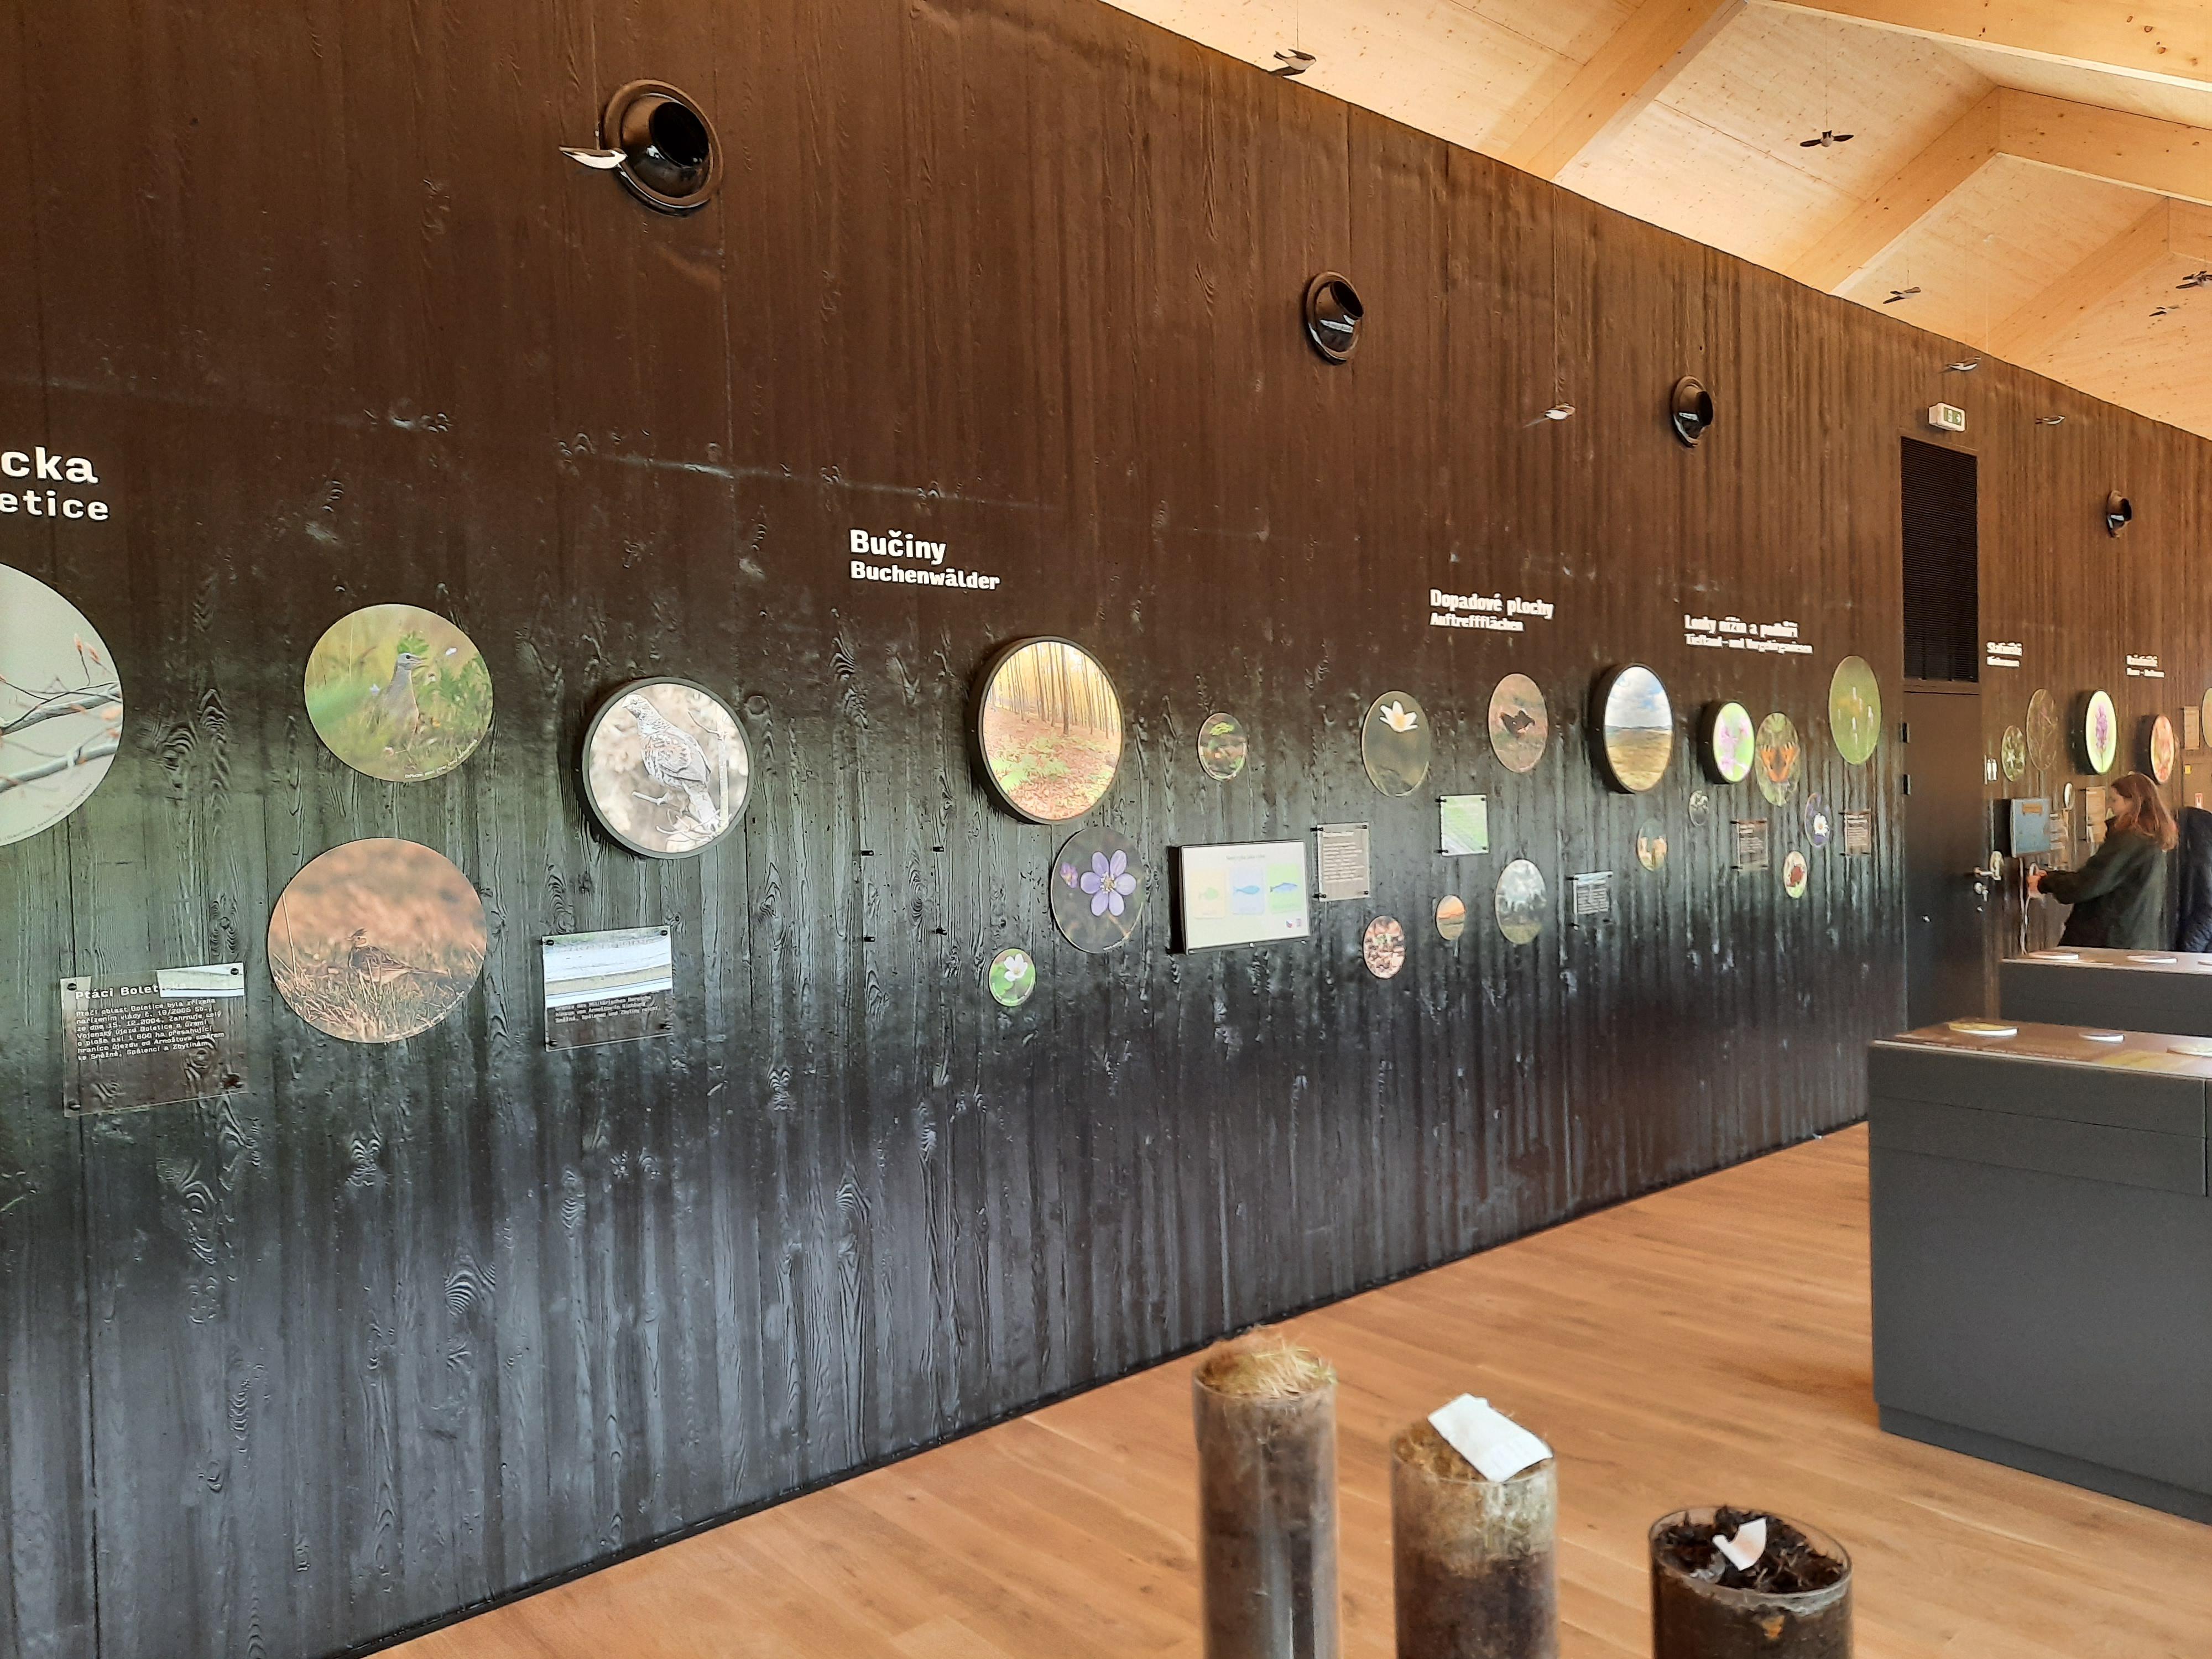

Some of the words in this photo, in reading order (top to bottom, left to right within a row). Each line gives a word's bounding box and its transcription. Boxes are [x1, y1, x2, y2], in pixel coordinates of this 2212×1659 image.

[1, 446, 98, 483] cka
[850, 529, 946, 565] Bučiny
[851, 561, 1000, 589] Buchenwälder
[1430, 588, 1503, 612] Dopadové
[1507, 597, 1554, 619] plochy
[1749, 624, 1759, 635] a
[75, 987, 114, 1000] Ptáci
